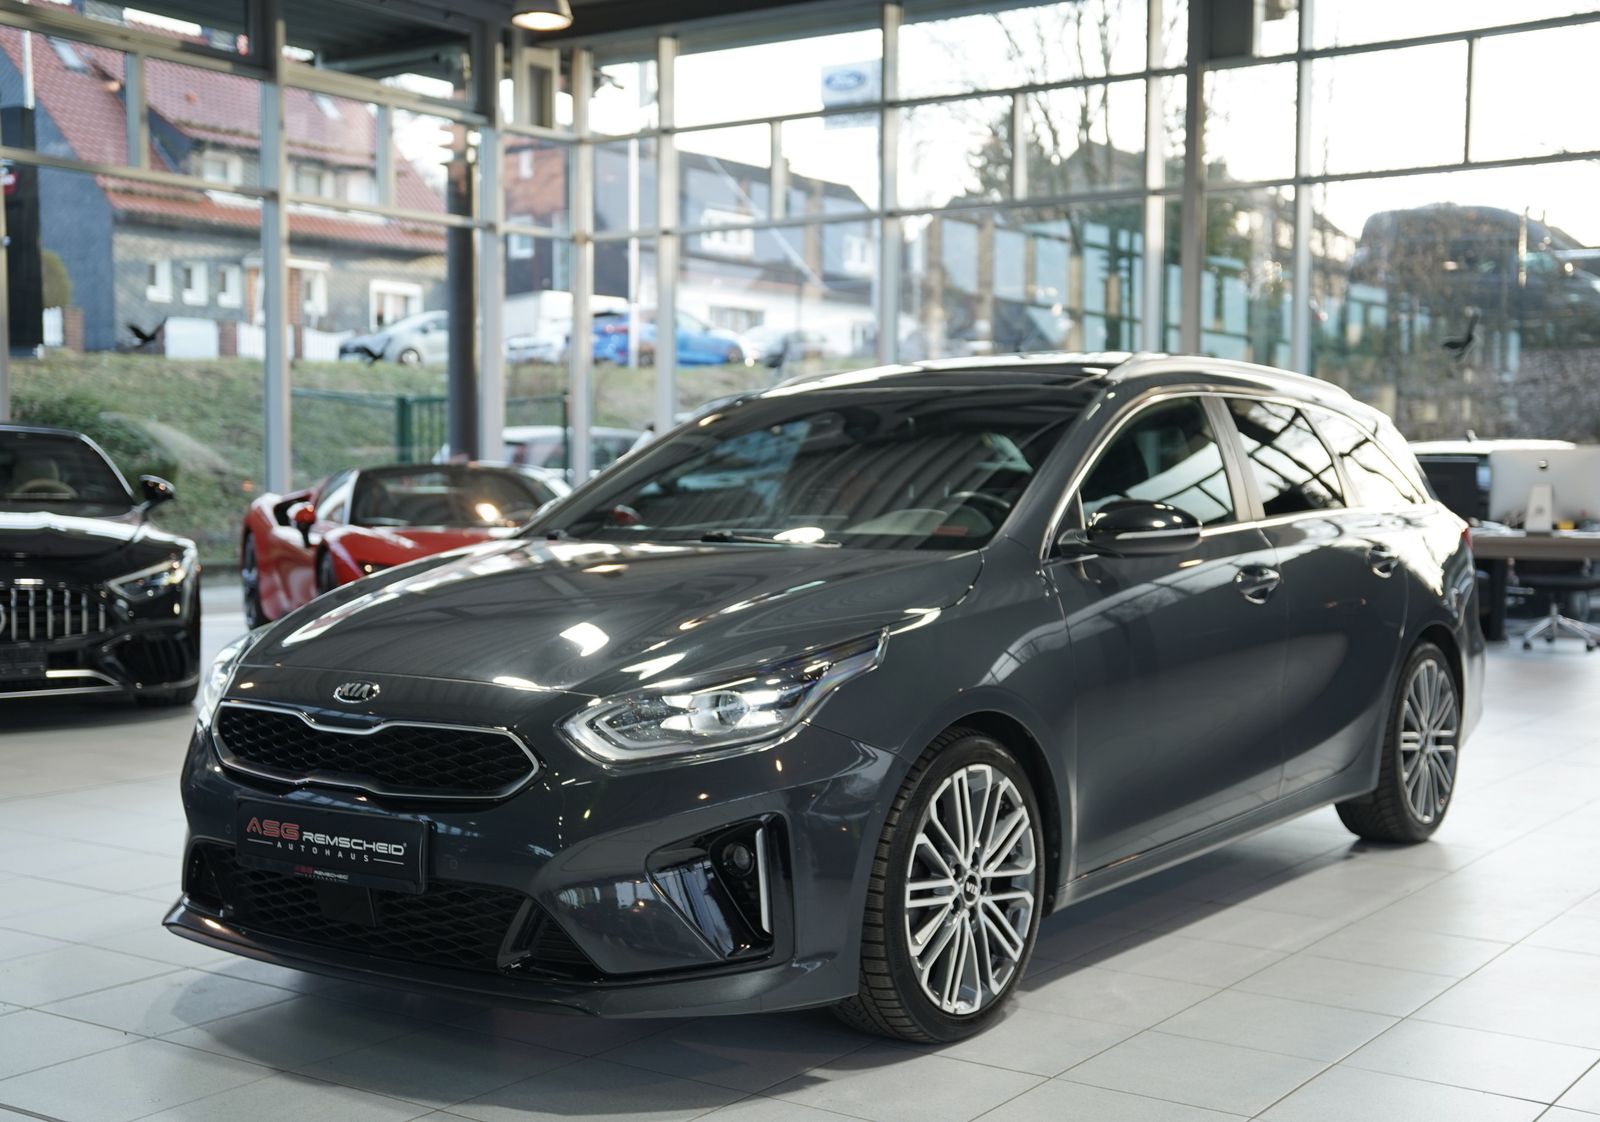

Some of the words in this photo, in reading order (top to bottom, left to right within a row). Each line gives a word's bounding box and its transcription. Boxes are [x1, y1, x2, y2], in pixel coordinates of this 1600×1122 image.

[339, 682, 371, 699] KIA
[246, 816, 300, 841] ASG
[302, 831, 405, 856] REMSCHEID
[277, 842, 369, 862] AUTOHAUS
